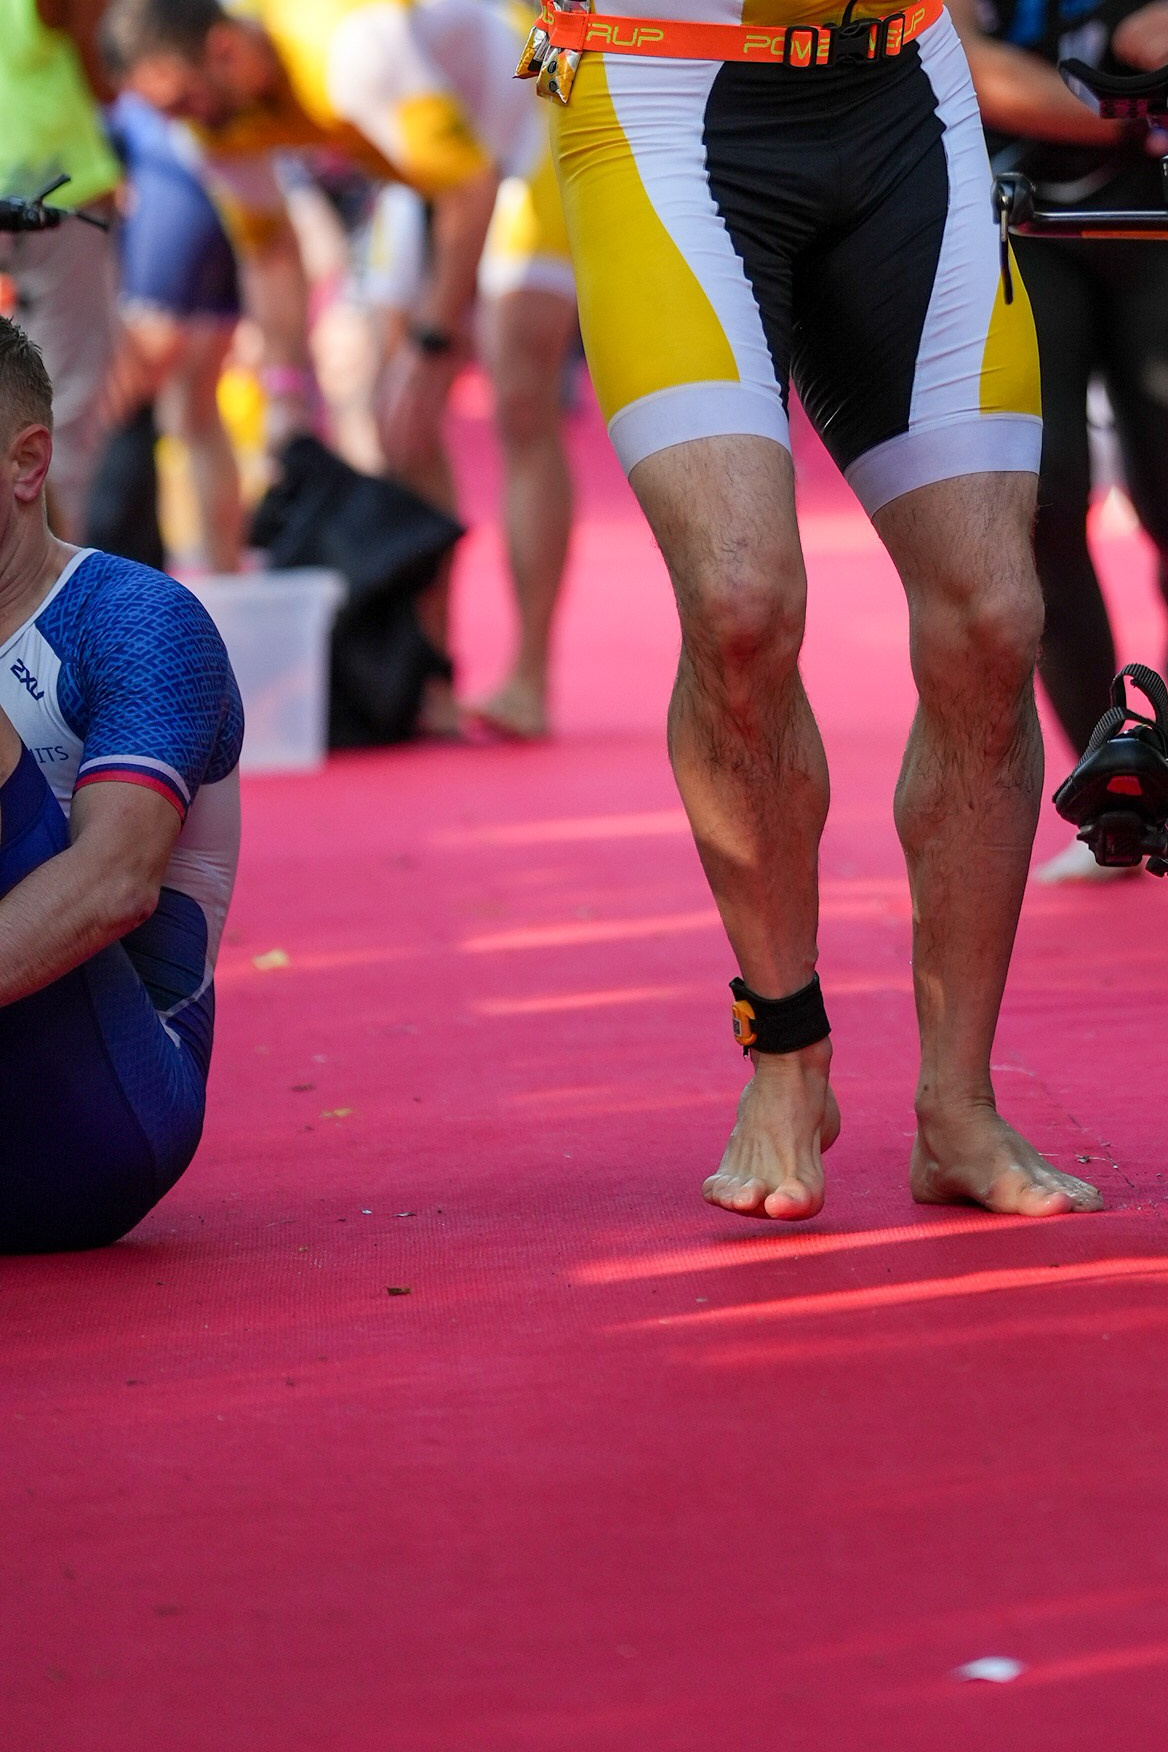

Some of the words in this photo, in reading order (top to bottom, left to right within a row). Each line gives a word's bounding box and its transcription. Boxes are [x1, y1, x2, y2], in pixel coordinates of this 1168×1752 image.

[586, 22, 664, 47] RUP
[743, 34, 830, 59] POWE
[30, 746, 69, 763] ITS
